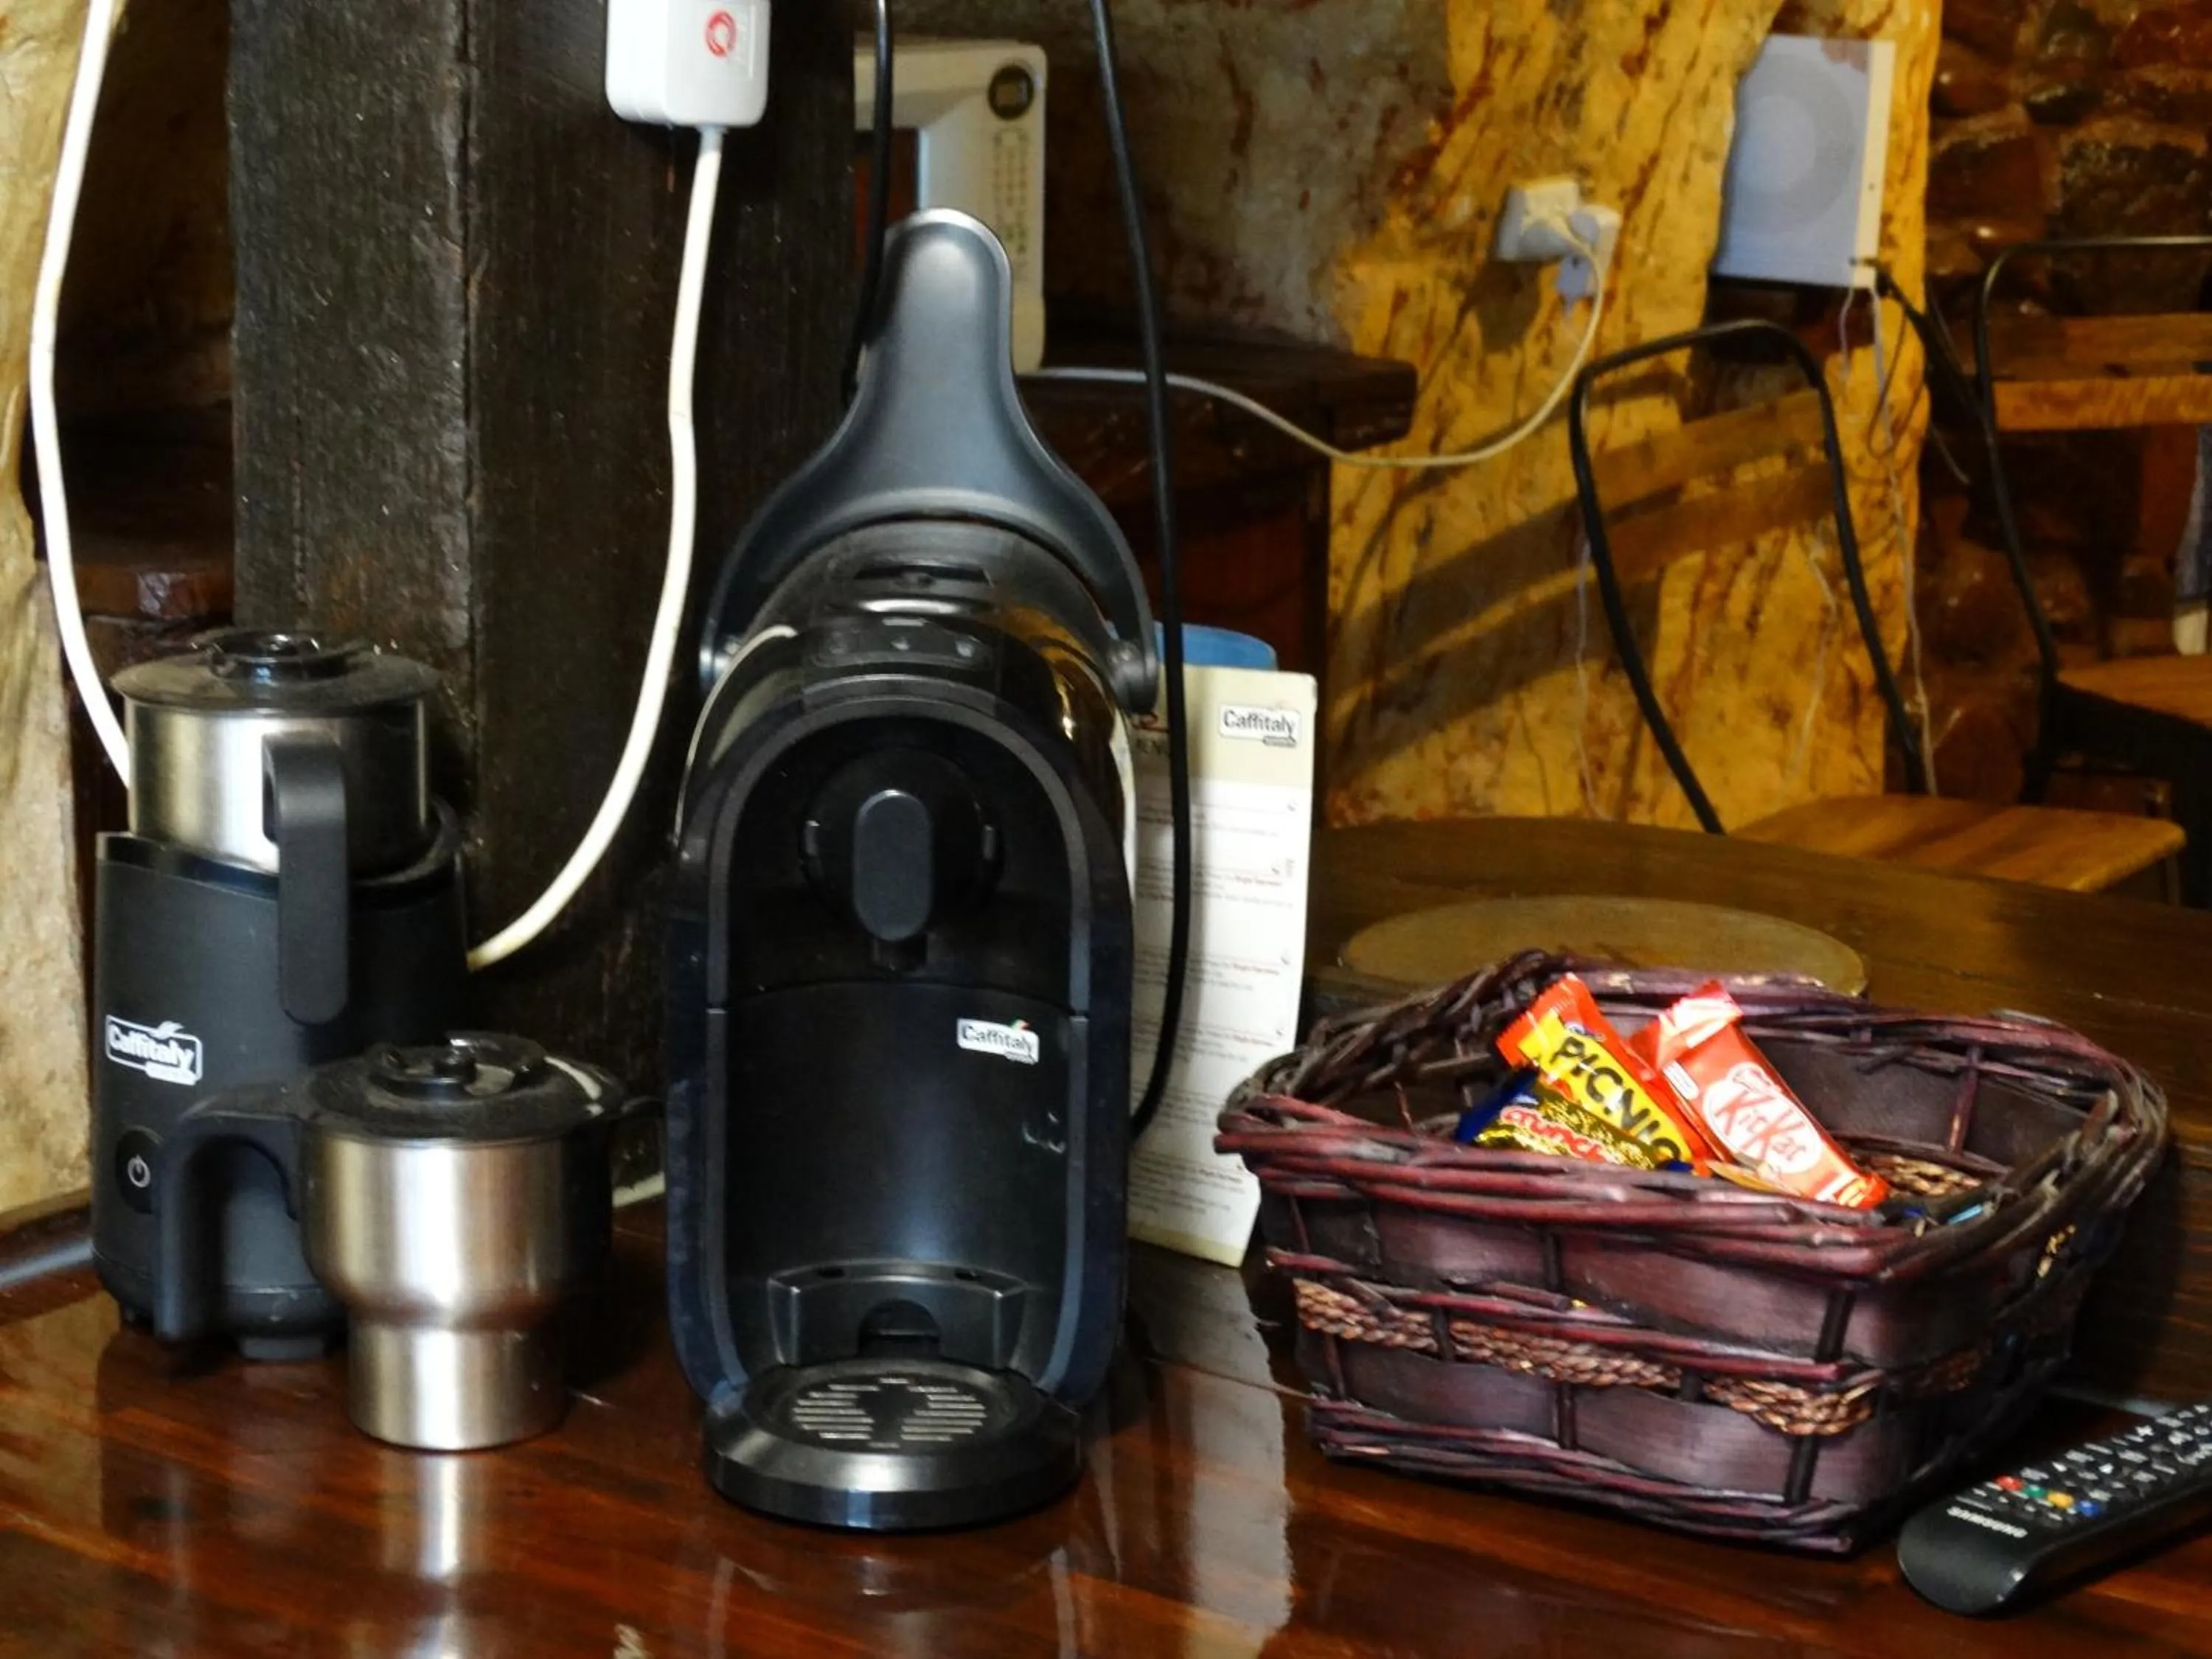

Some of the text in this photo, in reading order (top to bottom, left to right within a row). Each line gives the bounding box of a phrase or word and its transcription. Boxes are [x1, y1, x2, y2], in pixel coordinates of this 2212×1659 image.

[1224, 710, 1295, 737] Caffitaly
[110, 1024, 194, 1071] Caffitaly
[963, 1024, 1034, 1057] Caffitaly
